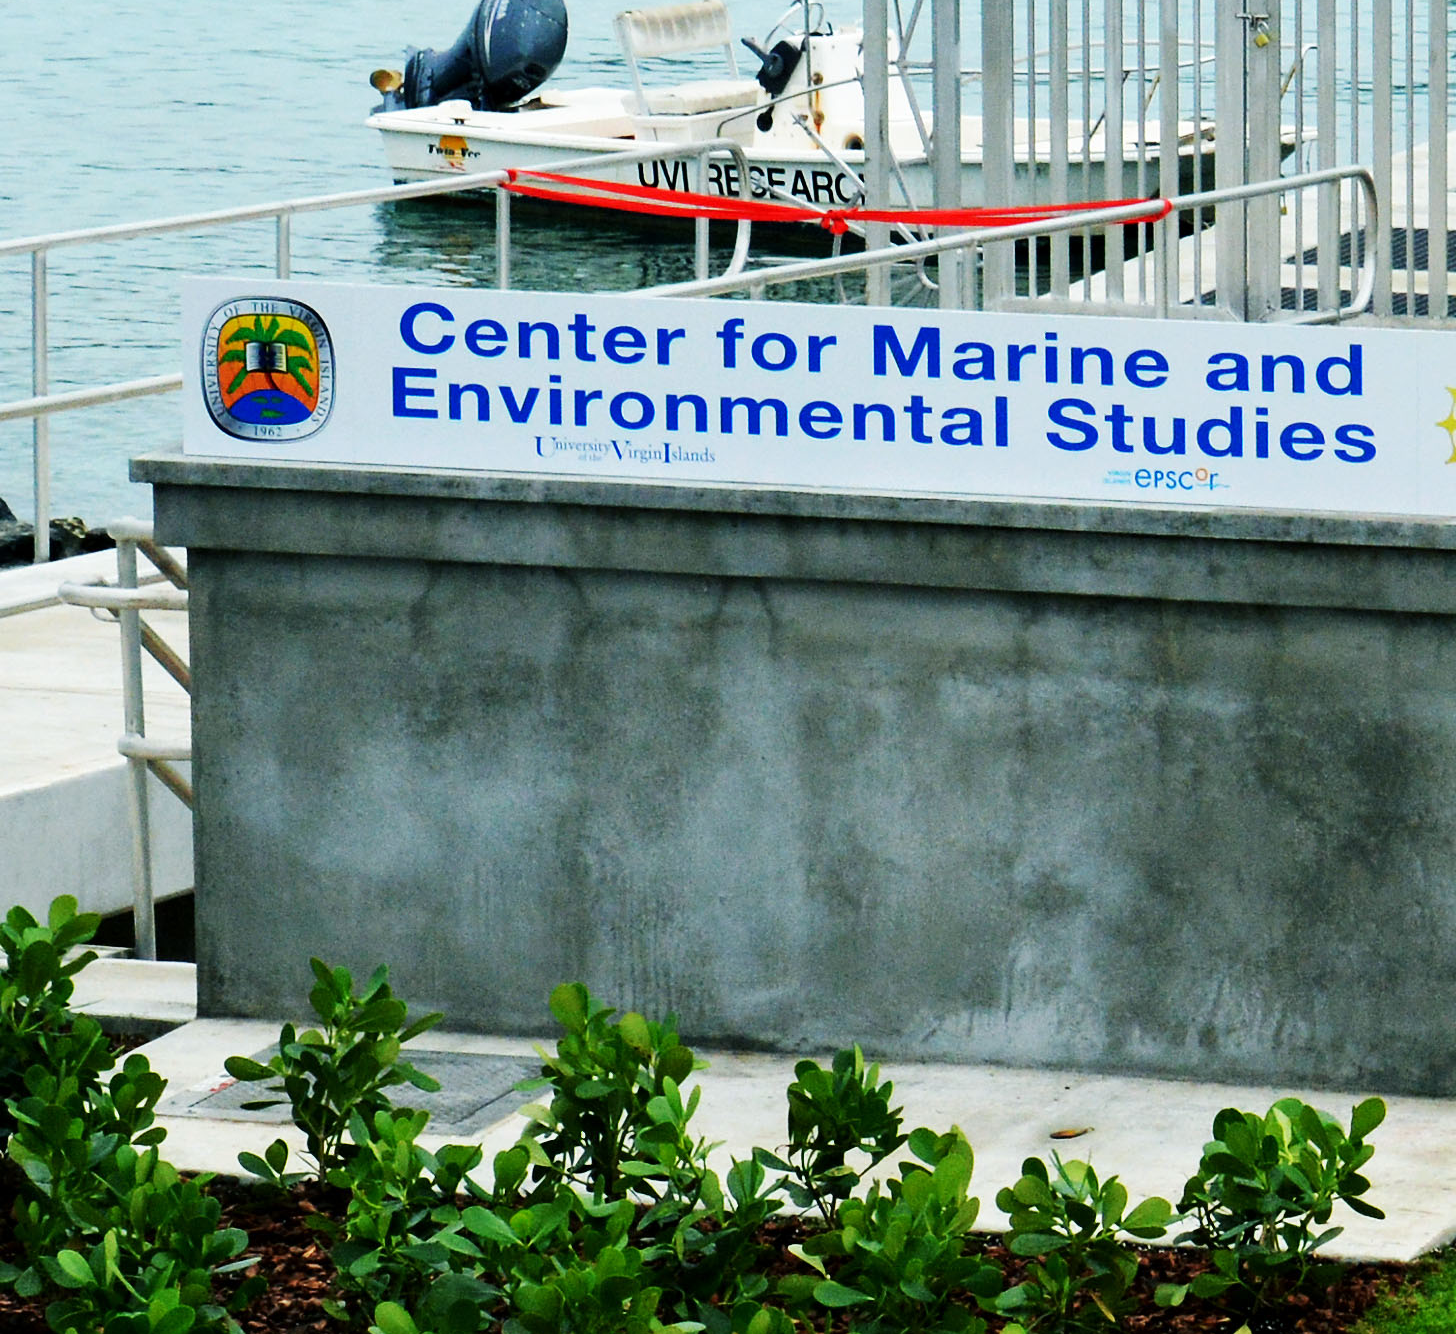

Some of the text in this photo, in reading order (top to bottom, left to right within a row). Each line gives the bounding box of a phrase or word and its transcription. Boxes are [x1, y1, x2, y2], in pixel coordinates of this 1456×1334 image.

[637, 159, 689, 193] UVI
[206, 301, 331, 424] UNIVERSITY OF THE VIRGIN ISLANDS
[399, 302, 1363, 396] Center for Marine and
[253, 425, 283, 438] 1962
[392, 366, 1377, 464] Environmental Studies
[534, 435, 716, 464] University Virgin Islands
